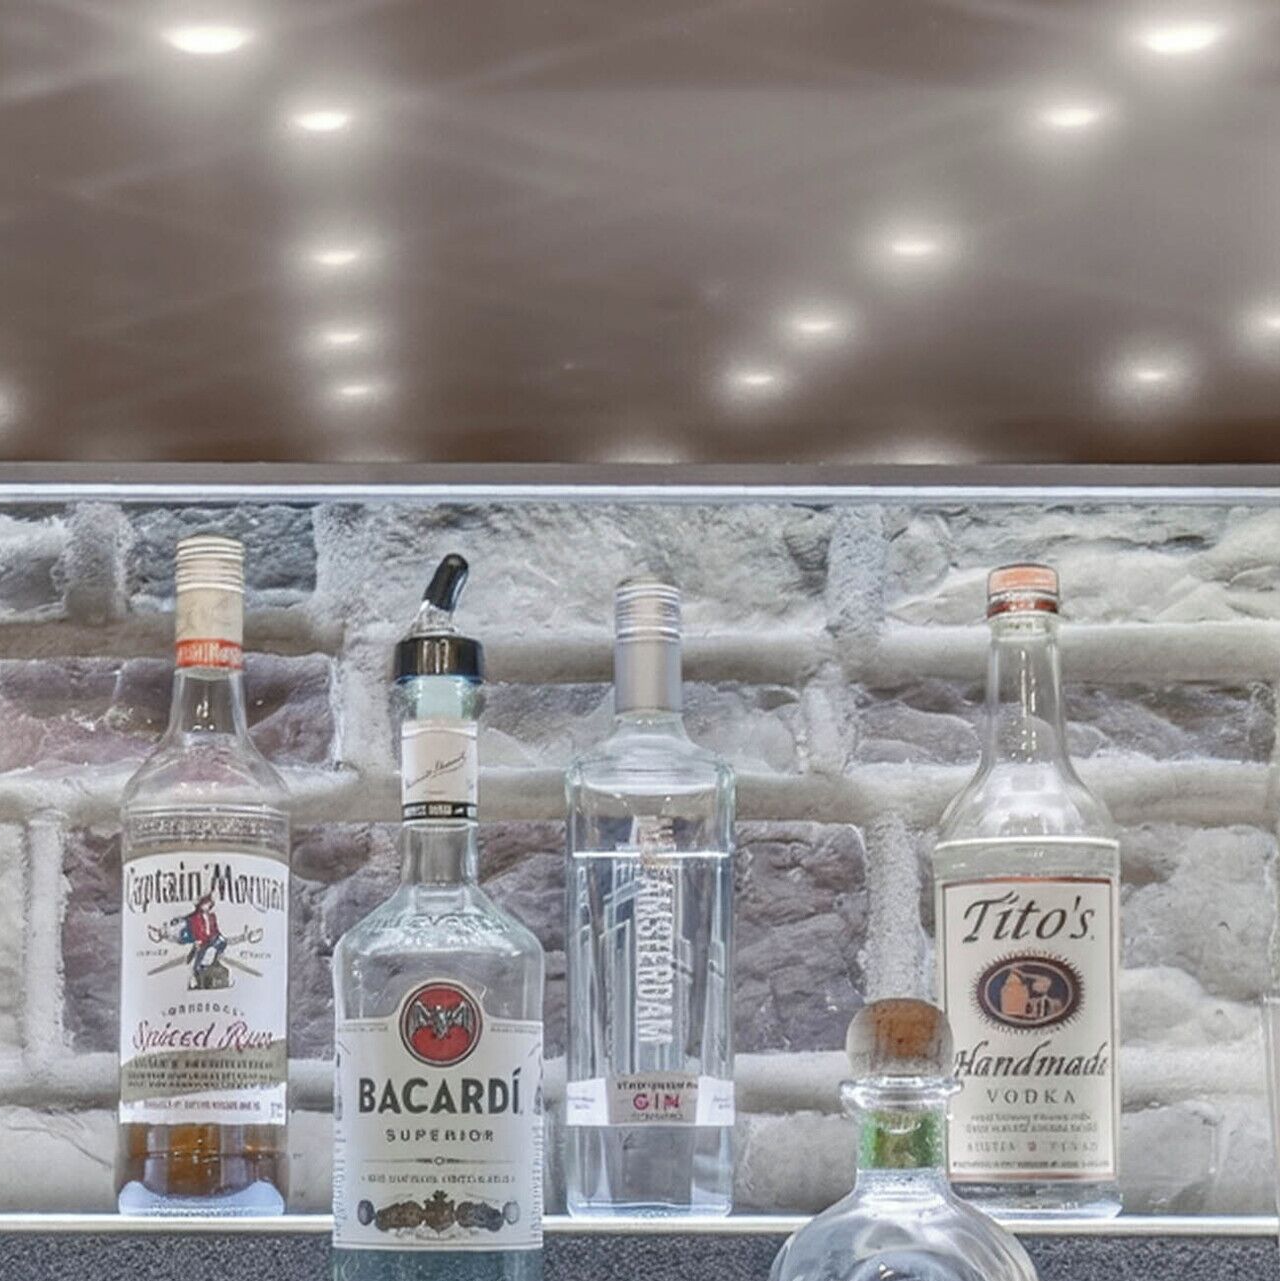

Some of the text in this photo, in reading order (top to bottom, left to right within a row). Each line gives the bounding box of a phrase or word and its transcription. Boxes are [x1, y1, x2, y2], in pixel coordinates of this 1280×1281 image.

[962, 891, 1095, 943] Tito's
[133, 1020, 273, 1052] Spiced Rum
[359, 1067, 522, 1114] BACARDÍ
[633, 1093, 680, 1110] GIN
[986, 1089, 1076, 1104] VODKA
[386, 1129, 494, 1142] SUPERIOR
